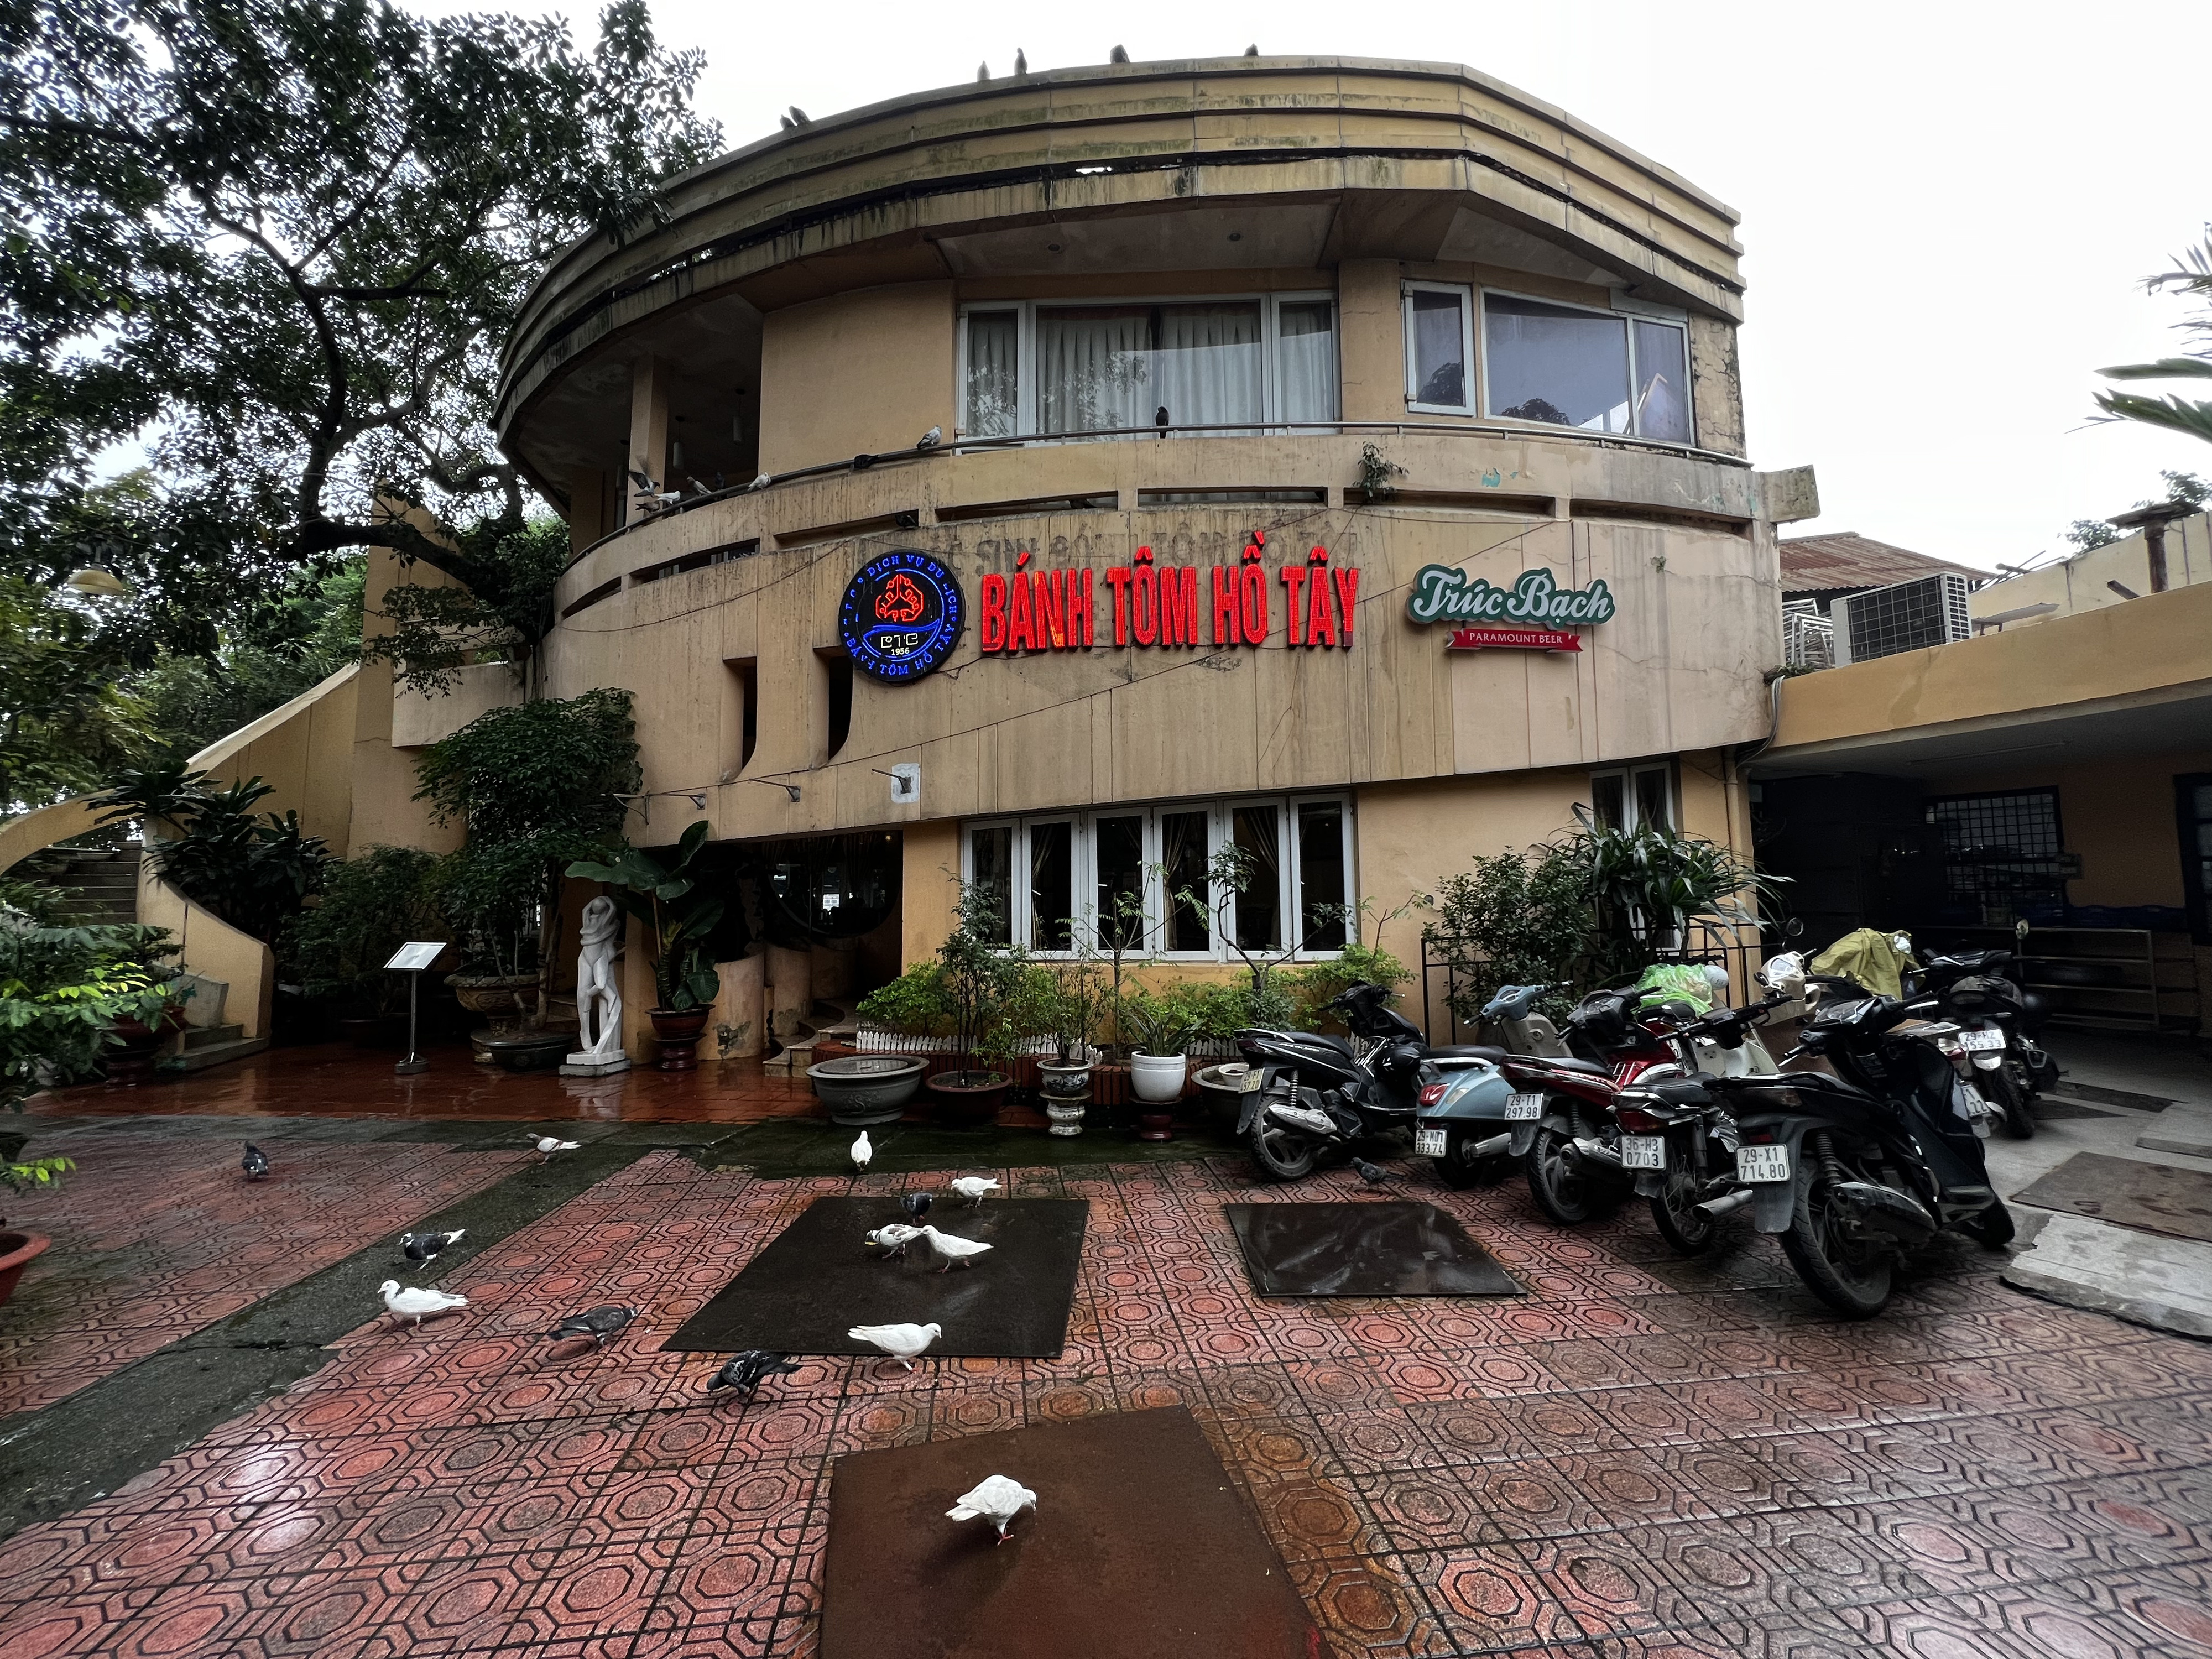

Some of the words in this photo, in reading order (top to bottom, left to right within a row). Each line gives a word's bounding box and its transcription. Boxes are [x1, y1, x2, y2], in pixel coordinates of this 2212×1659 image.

[867, 555, 899, 577] DỊCH
[906, 555, 924, 567] VỤ
[927, 561, 945, 578] DU
[982, 552, 1093, 653] BÁNH
[1106, 546, 1198, 645] TÔM
[1212, 531, 1268, 645] HỒ
[1280, 546, 1359, 647] TÂY
[1413, 570, 1503, 617] Trúc
[1507, 573, 1610, 624] Bạch
[1469, 632, 1536, 644] PARAMOUNT
[1539, 635, 1563, 644] BEER
[891, 648, 910, 656] 1956
[880, 663, 909, 675] TÔM
[1510, 1095, 1536, 1106] 29-T1
[1506, 1107, 1537, 1118] 297.98
[1416, 1142, 1442, 1155] 333.74
[1626, 1138, 1658, 1152] 36-H3
[1627, 1152, 1658, 1166] 0703
[1744, 1147, 1778, 1163] 29-X1
[1741, 1164, 1785, 1180] 714.80
